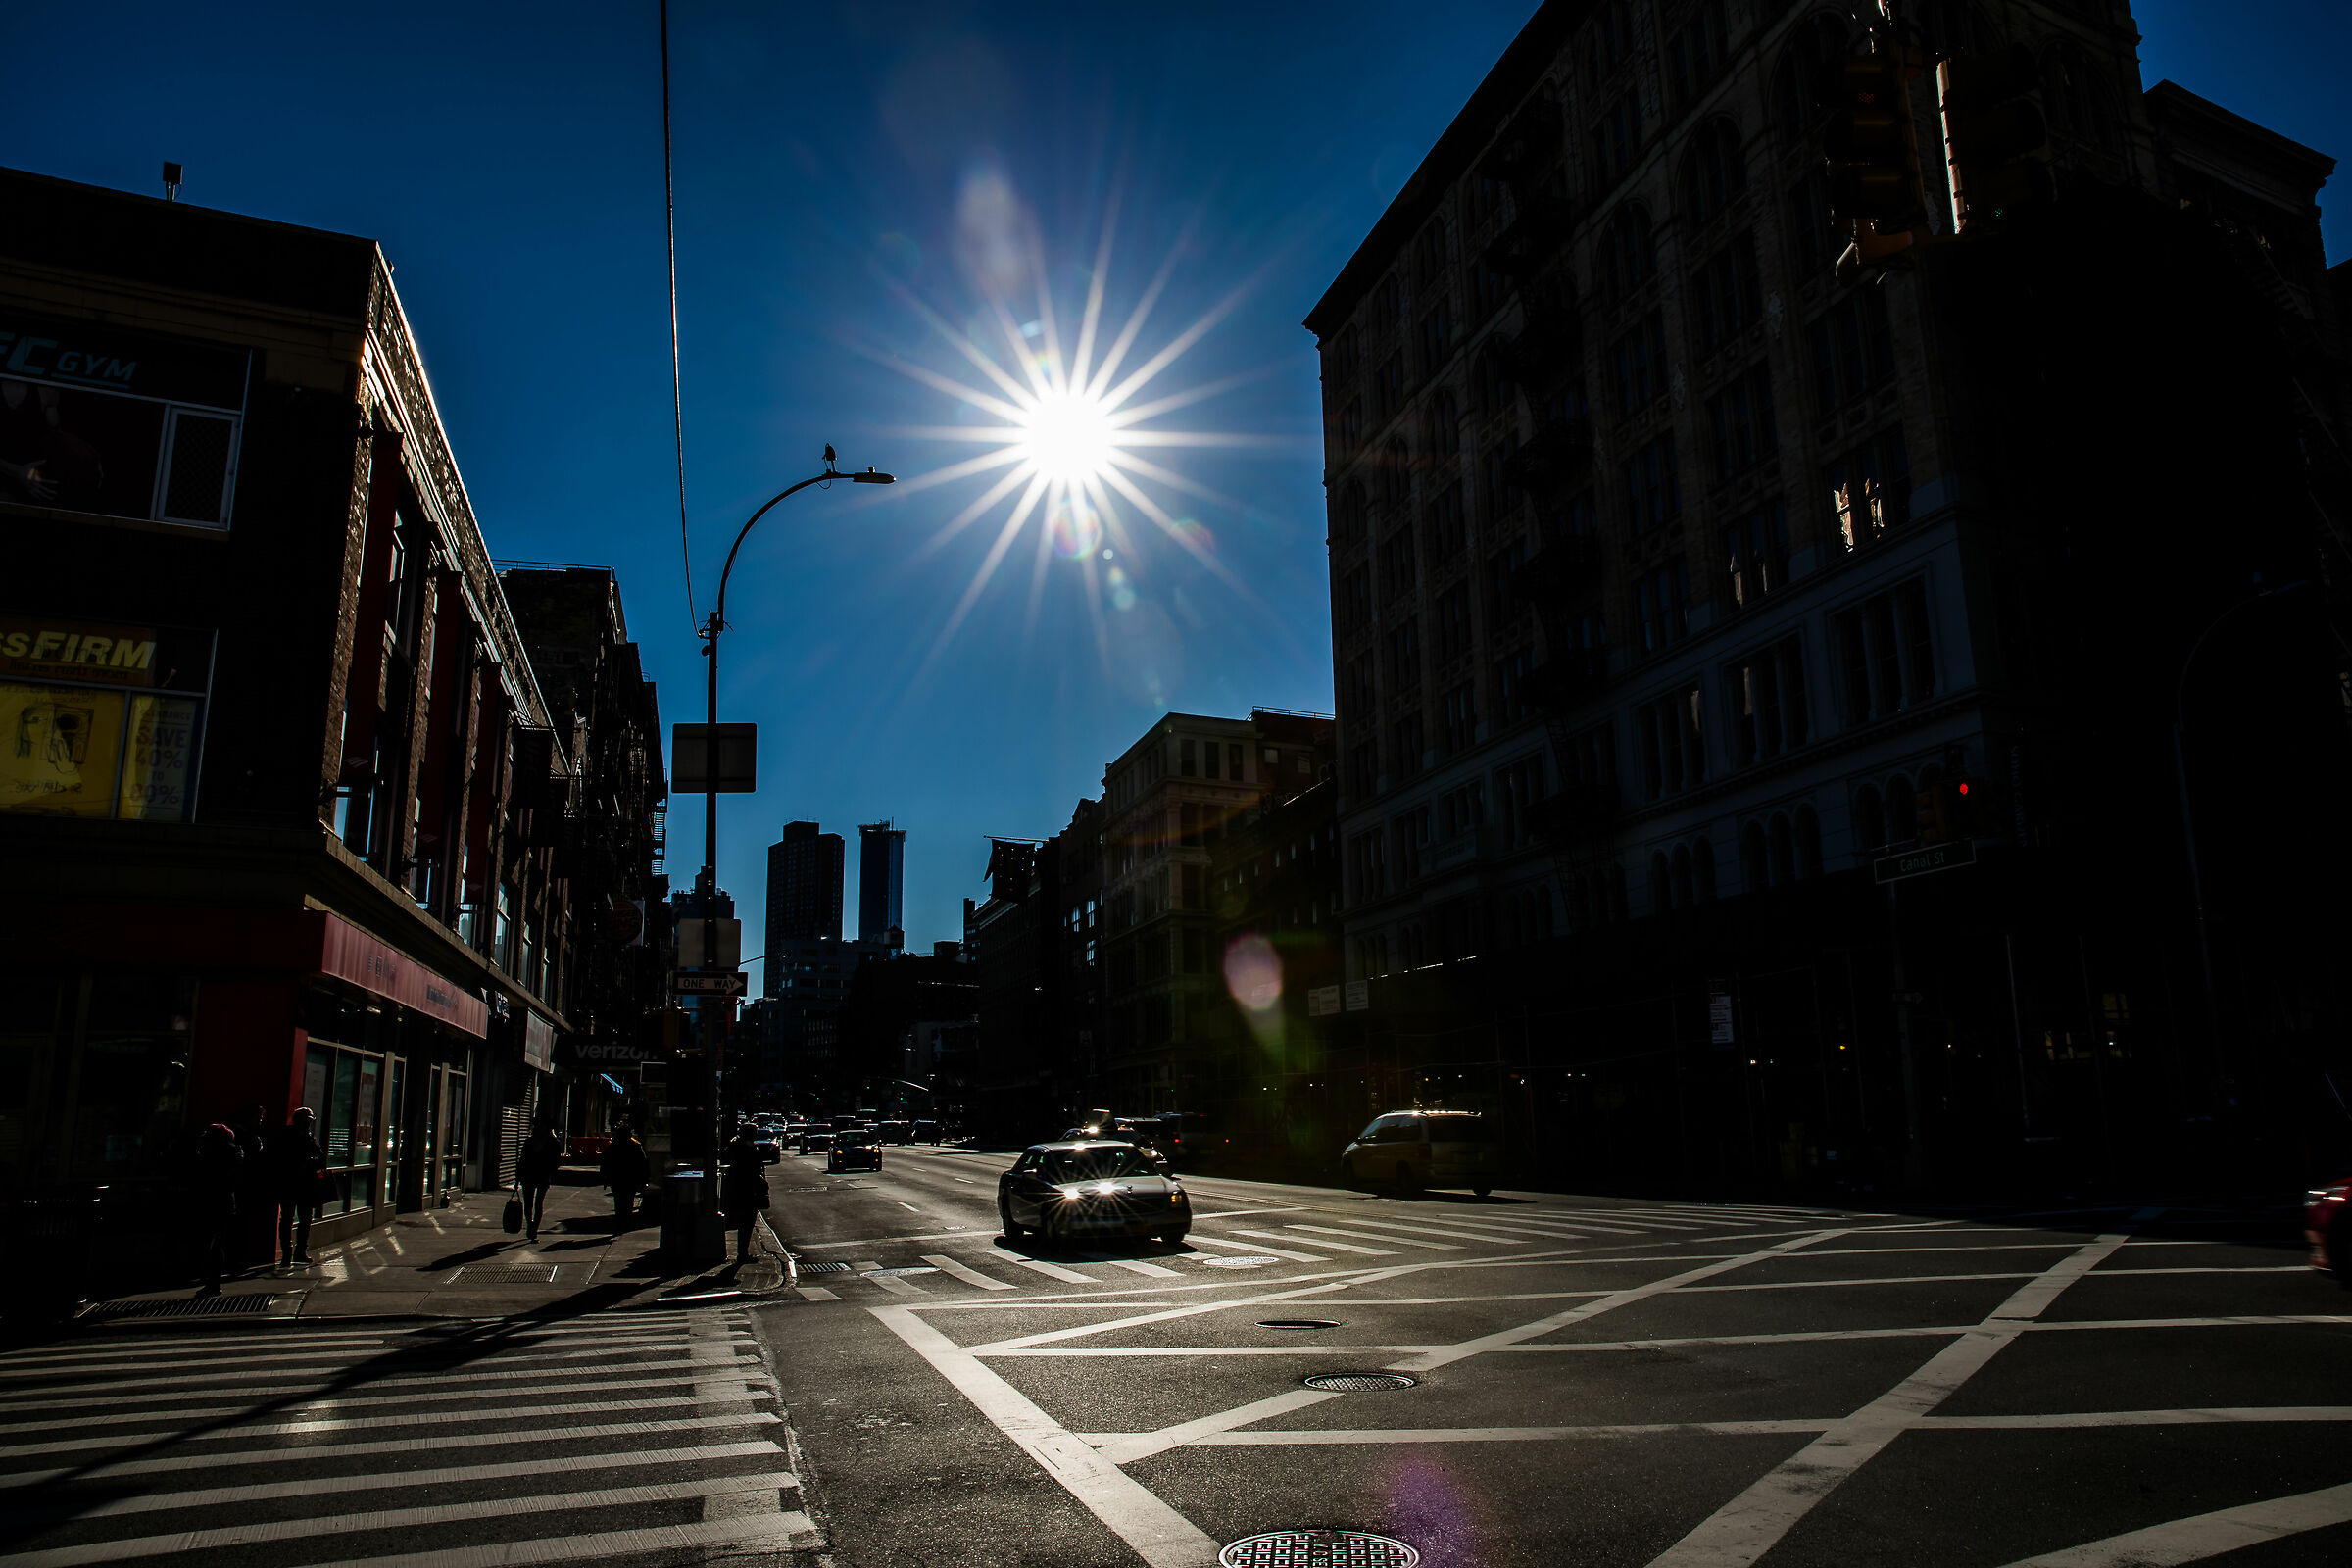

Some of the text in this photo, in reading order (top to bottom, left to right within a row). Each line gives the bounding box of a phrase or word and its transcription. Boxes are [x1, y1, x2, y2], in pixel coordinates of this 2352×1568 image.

[56, 350, 140, 382] GYM
[136, 725, 188, 749] SAVE
[1899, 850, 1945, 872] Canal St
[683, 978, 737, 989] ONE WAY
